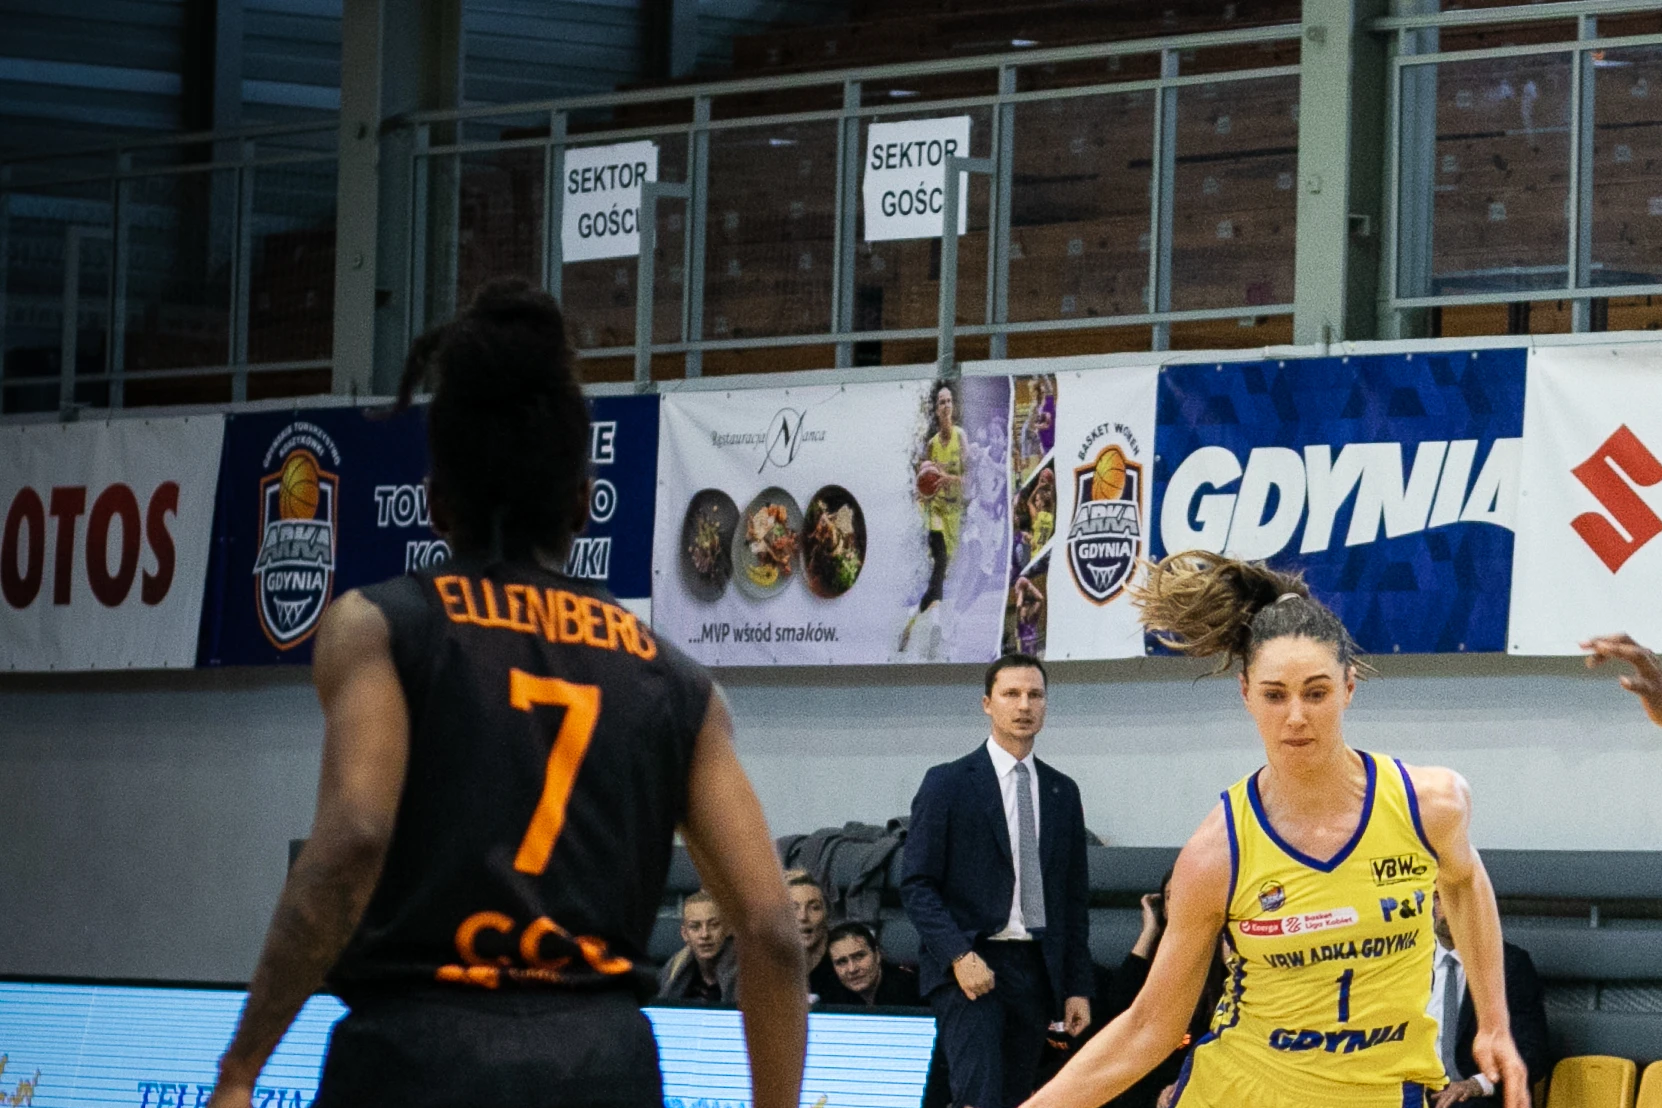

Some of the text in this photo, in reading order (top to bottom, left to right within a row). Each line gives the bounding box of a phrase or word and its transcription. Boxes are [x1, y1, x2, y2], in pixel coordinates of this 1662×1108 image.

[871, 139, 957, 170] SEKTOR
[568, 162, 647, 194] SEKTOR
[881, 181, 943, 217] GOŚC
[1078, 423, 1109, 460] BASKET
[1161, 436, 1523, 561] GDYNIA
[1068, 502, 1140, 540] ARKA
[0, 480, 180, 610] OTOS
[1079, 541, 1131, 560] GDYNIA
[267, 571, 323, 592] GDYNIA
[434, 576, 657, 660] ELLENBERG
[733, 622, 772, 643] wśród
[775, 622, 839, 643] smaków.
[510, 668, 601, 877] 7
[1373, 855, 1413, 882] VBW
[1336, 969, 1354, 1022] 1
[1269, 1020, 1409, 1054] GDYNIA
